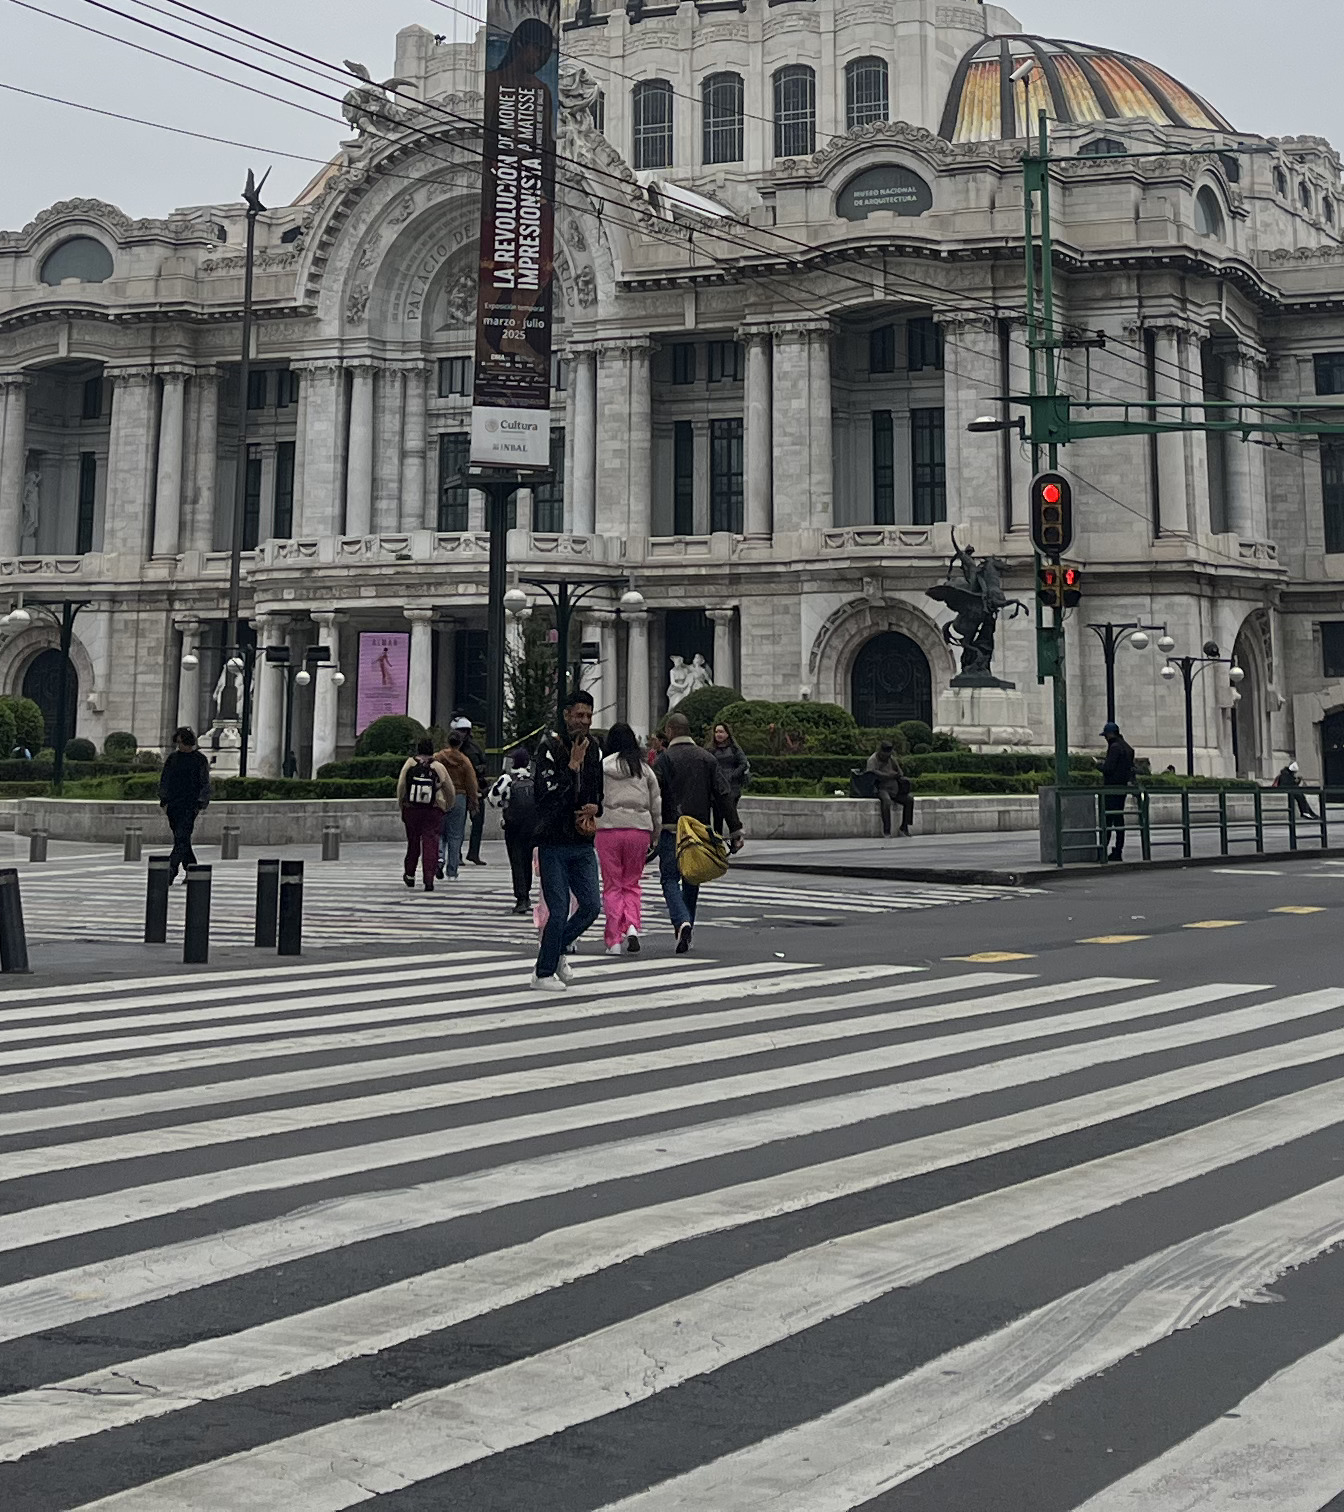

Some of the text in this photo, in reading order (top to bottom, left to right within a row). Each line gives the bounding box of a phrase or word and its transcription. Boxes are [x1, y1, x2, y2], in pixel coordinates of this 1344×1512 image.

[499, 85, 516, 130] MONET
[517, 86, 535, 139] MATISSE
[491, 154, 518, 262] REVOLUCIÓN
[517, 157, 542, 290] IMPRESIONISTA
[407, 224, 476, 321] PALACIO DE
[493, 268, 515, 289] LA
[484, 302, 545, 313] Exposición temporal
[483, 317, 545, 330] marzo julio
[501, 329, 526, 340] 2025
[500, 419, 538, 431] Cultura
[500, 443, 528, 453] INBAL
